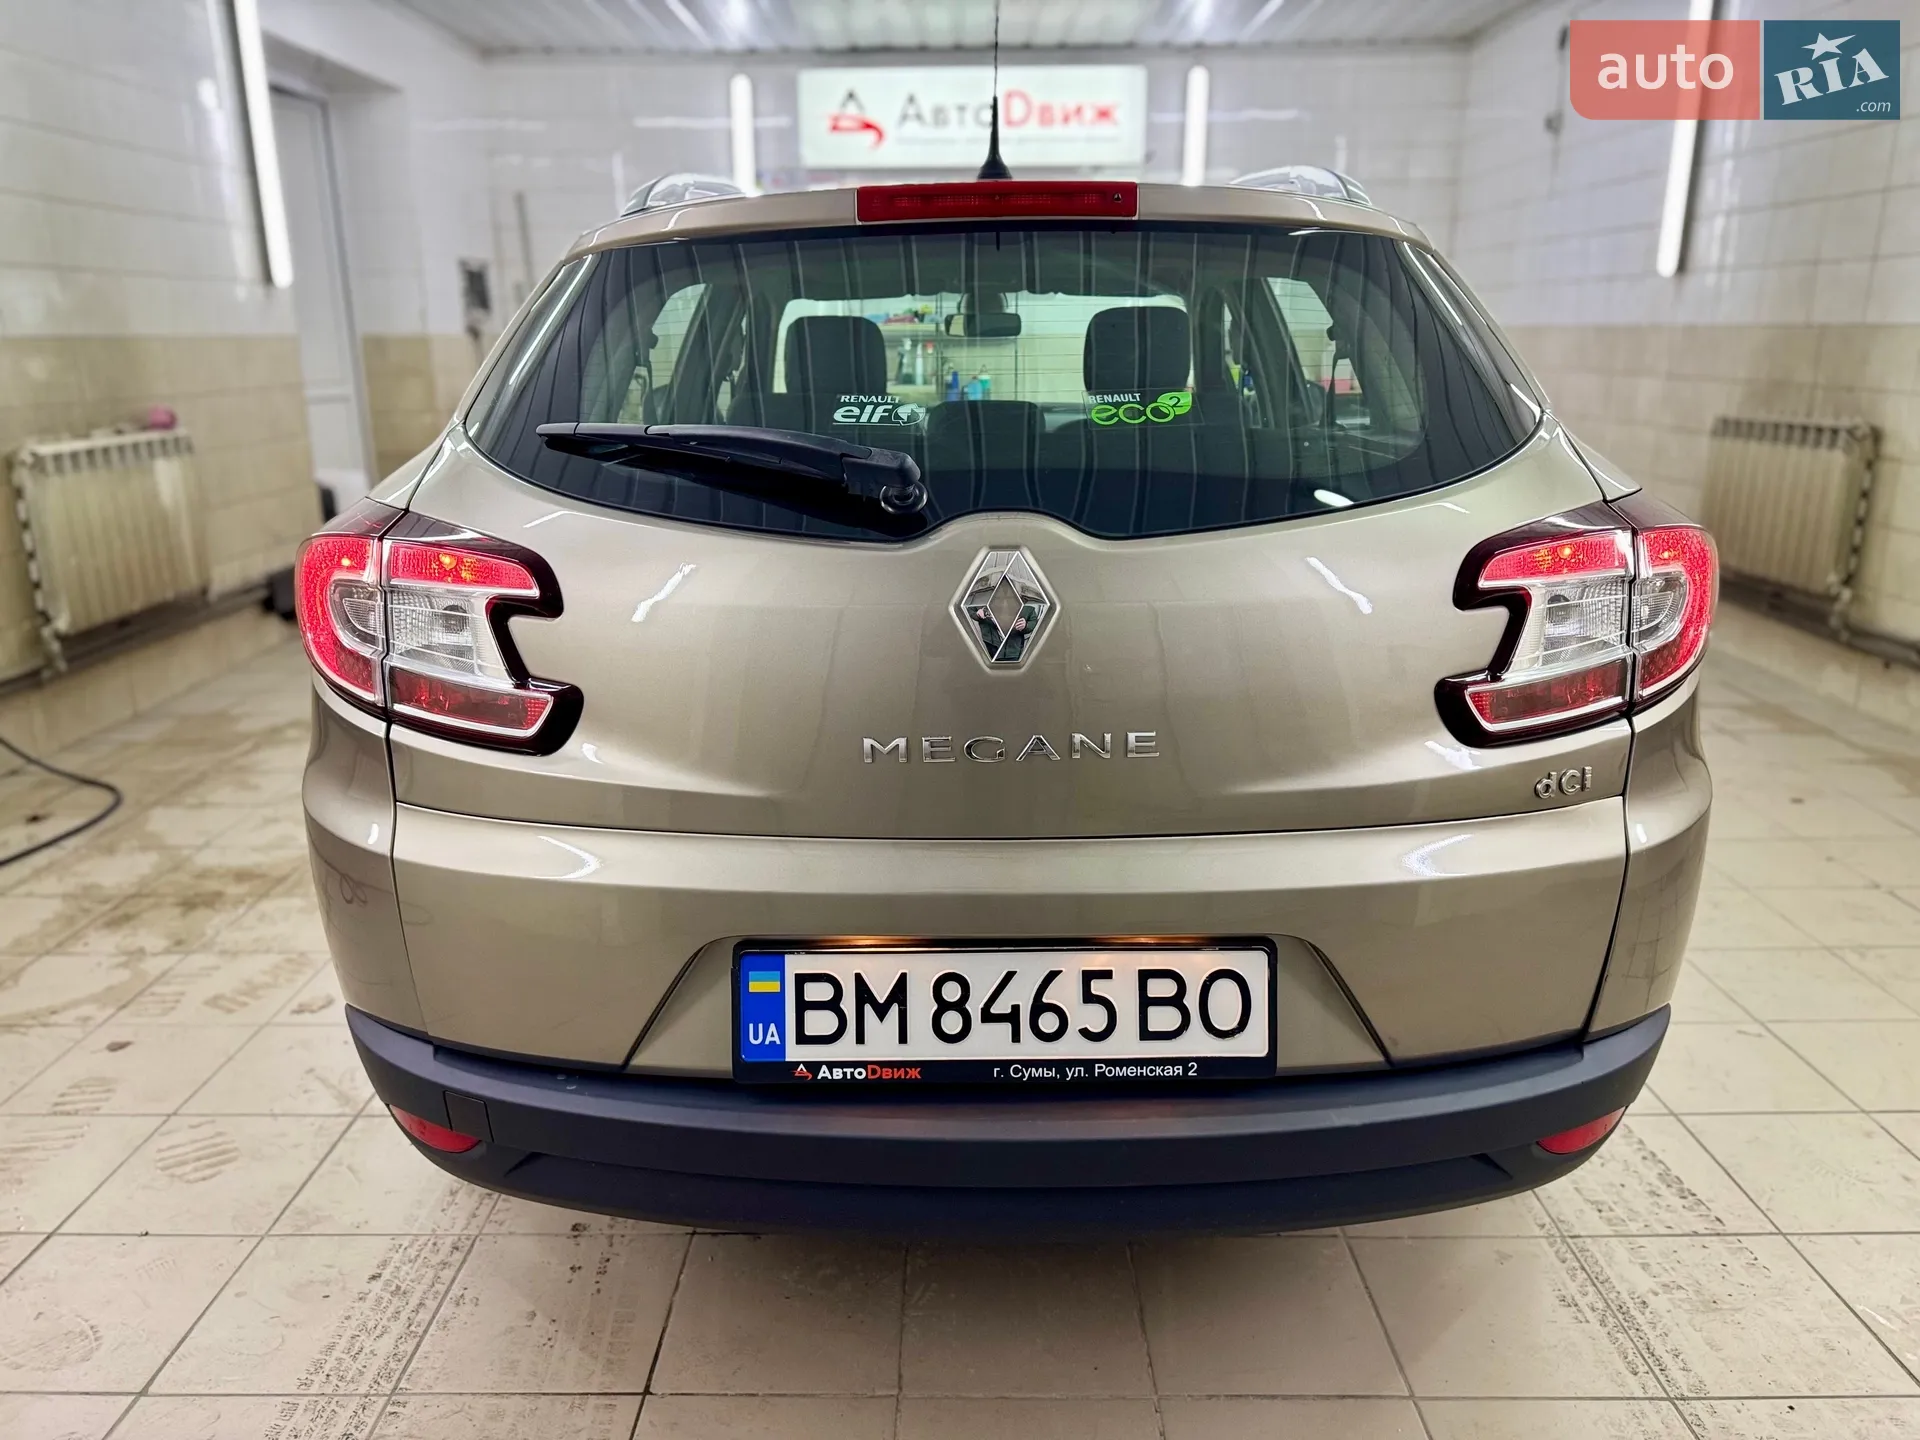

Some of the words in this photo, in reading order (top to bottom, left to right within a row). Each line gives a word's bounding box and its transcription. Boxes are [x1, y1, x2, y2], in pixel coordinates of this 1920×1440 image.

[840, 395, 901, 404] RENAULT
[1087, 393, 1141, 404] RENAULT
[833, 404, 893, 423] elf
[862, 731, 1160, 764] MEGANE
[794, 971, 909, 1046] BM
[931, 968, 1118, 1045] 8465
[1137, 967, 1252, 1042] BO
[748, 1022, 781, 1045] UA
[993, 1066, 1004, 1078] г.
[1009, 1064, 1060, 1081] Сумы,
[1065, 1066, 1089, 1081] ул.
[1094, 1063, 1183, 1078] Роменская
[1187, 1062, 1198, 1077] 2
